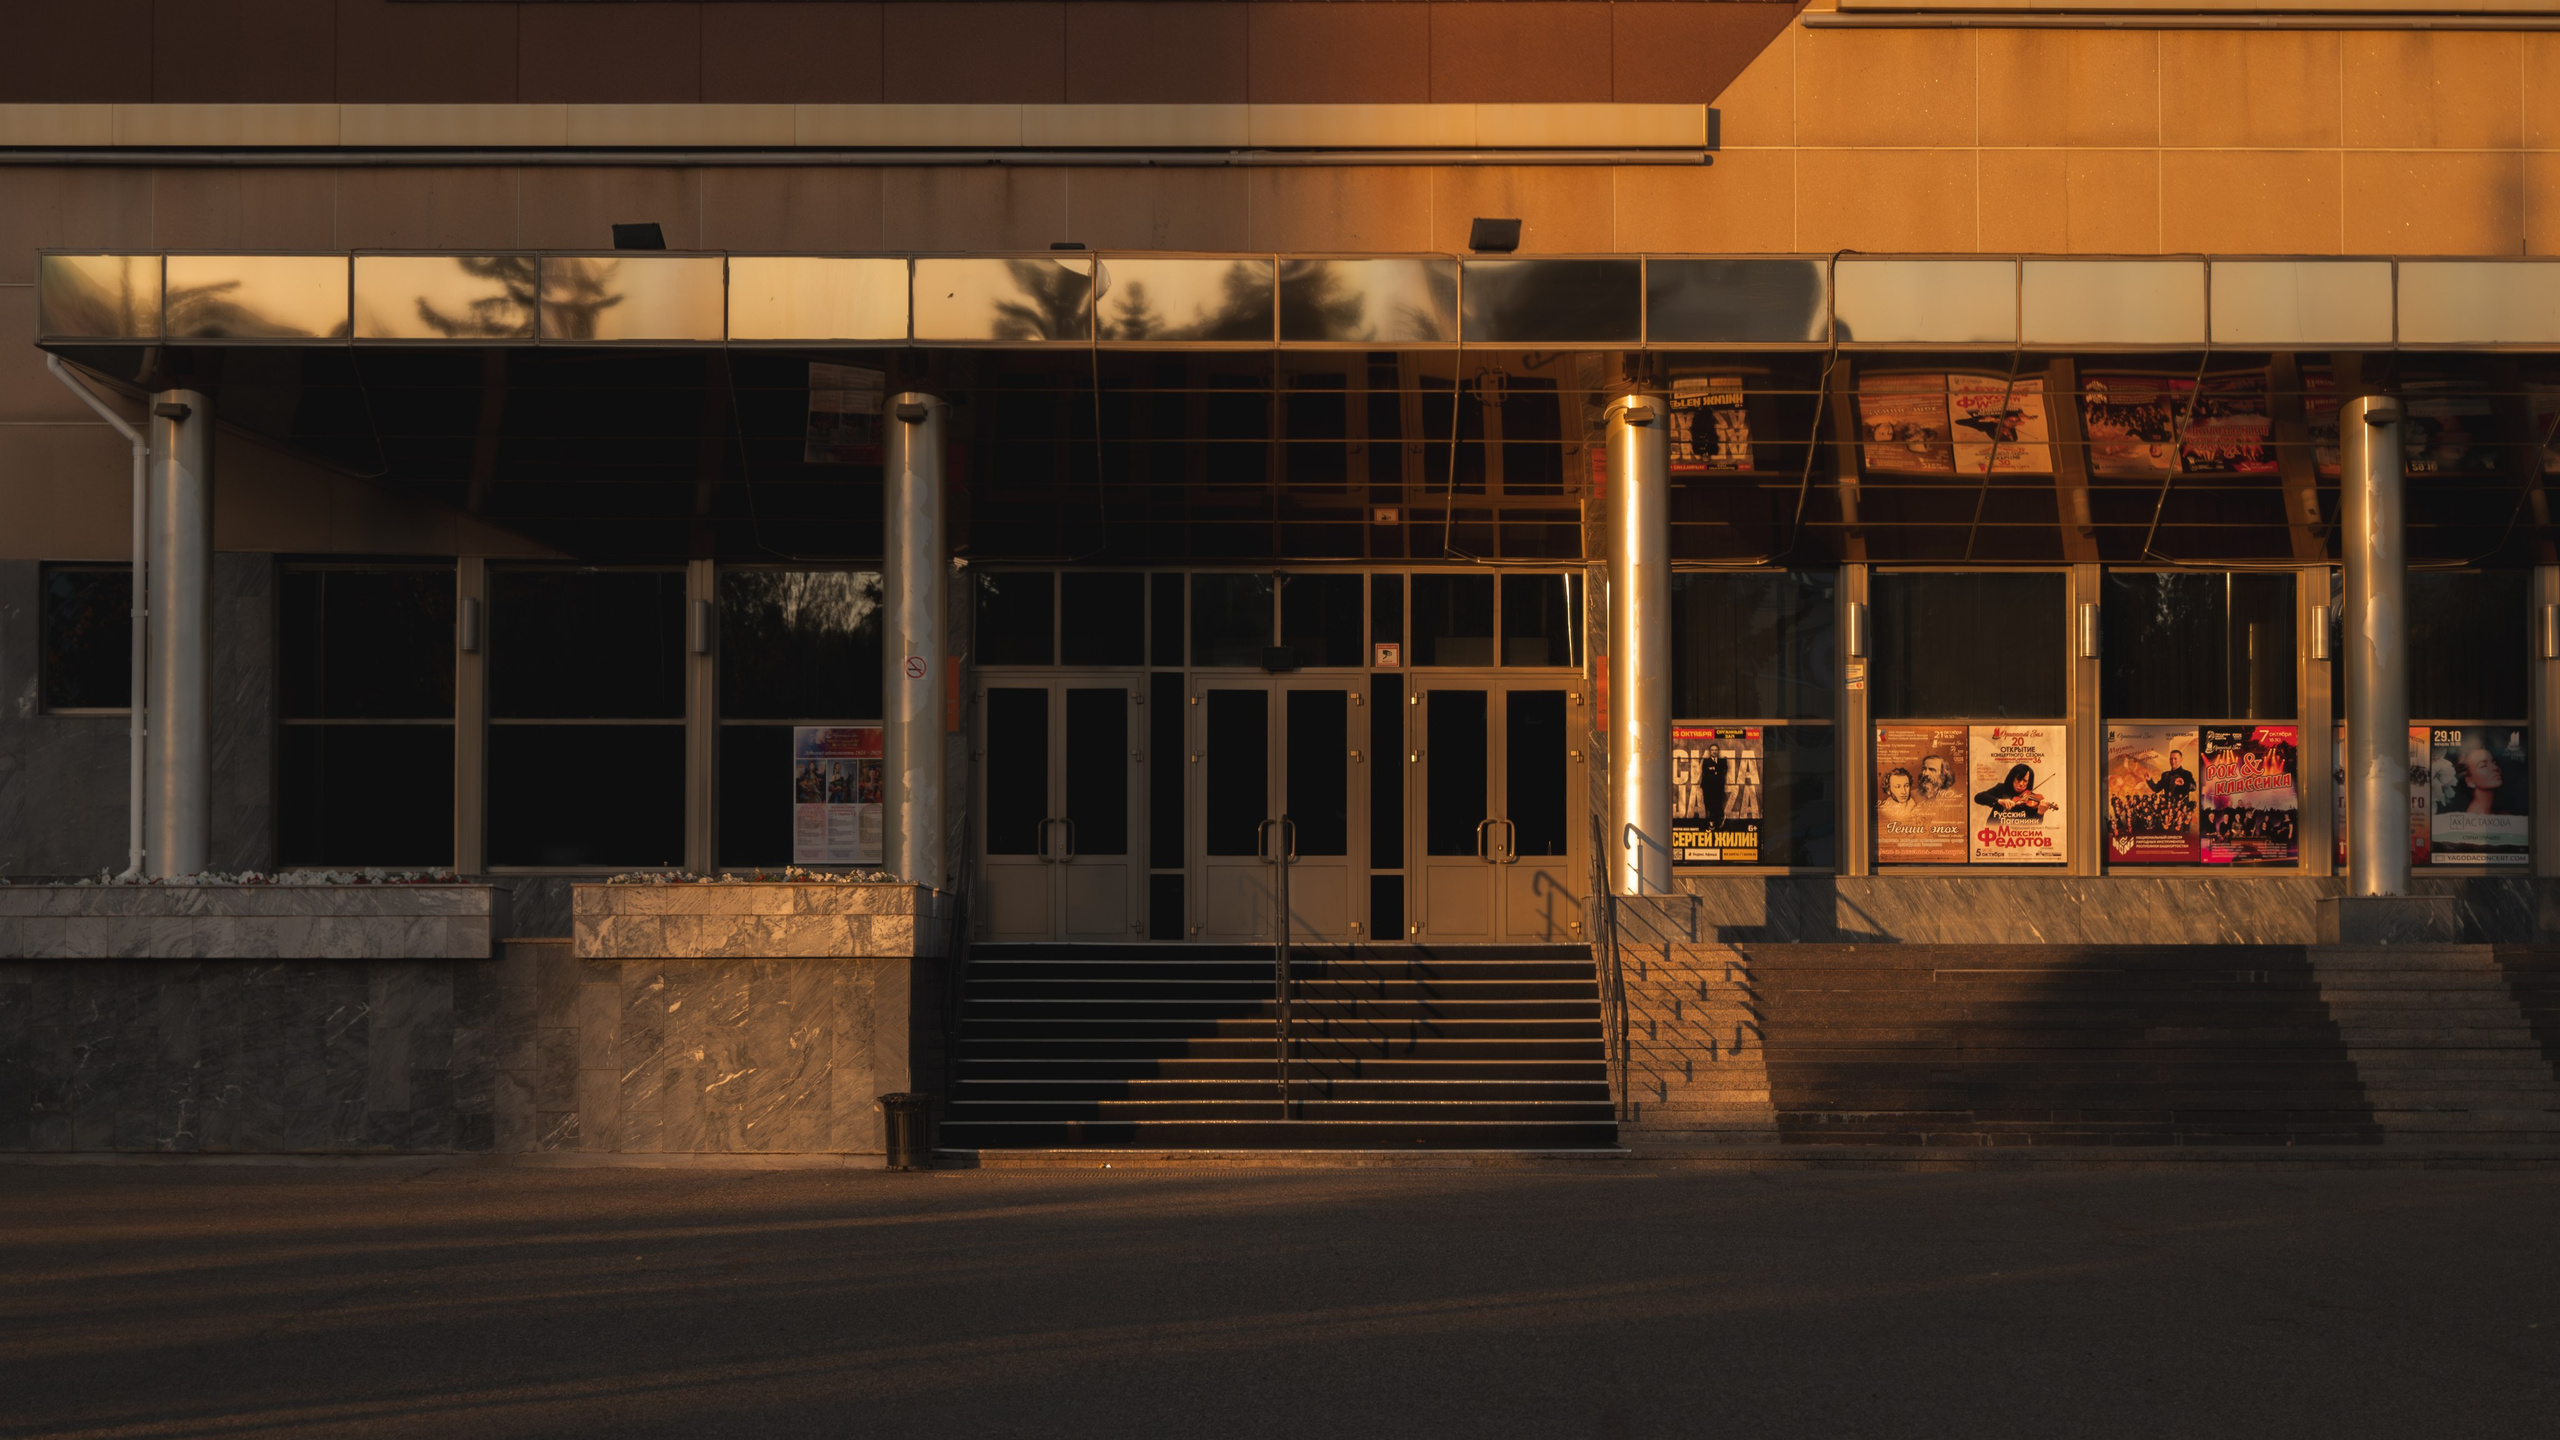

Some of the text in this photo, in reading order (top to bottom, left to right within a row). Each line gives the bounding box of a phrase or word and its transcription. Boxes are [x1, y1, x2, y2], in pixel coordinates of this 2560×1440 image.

[2011, 737, 2025, 747] 20
[2259, 730, 2269, 742] 7
[2434, 730, 2461, 742] 29.10
[2207, 752, 2265, 780] РОК &
[2215, 772, 2292, 795] КЛАССИКА
[1993, 809, 2026, 819] Русский
[2000, 817, 2039, 825] Паганини
[2465, 818, 2512, 827] АСТАХОВА
[1747, 824, 1758, 832] 6+
[1887, 821, 1959, 834] Гении эпох
[1998, 825, 2043, 837] Максим
[1673, 829, 1758, 847] СЕРГЕЙ ЖИЛИН
[1977, 827, 2052, 849] Федотов
[1976, 848, 1982, 857] 5
[1981, 850, 2005, 858] октября
